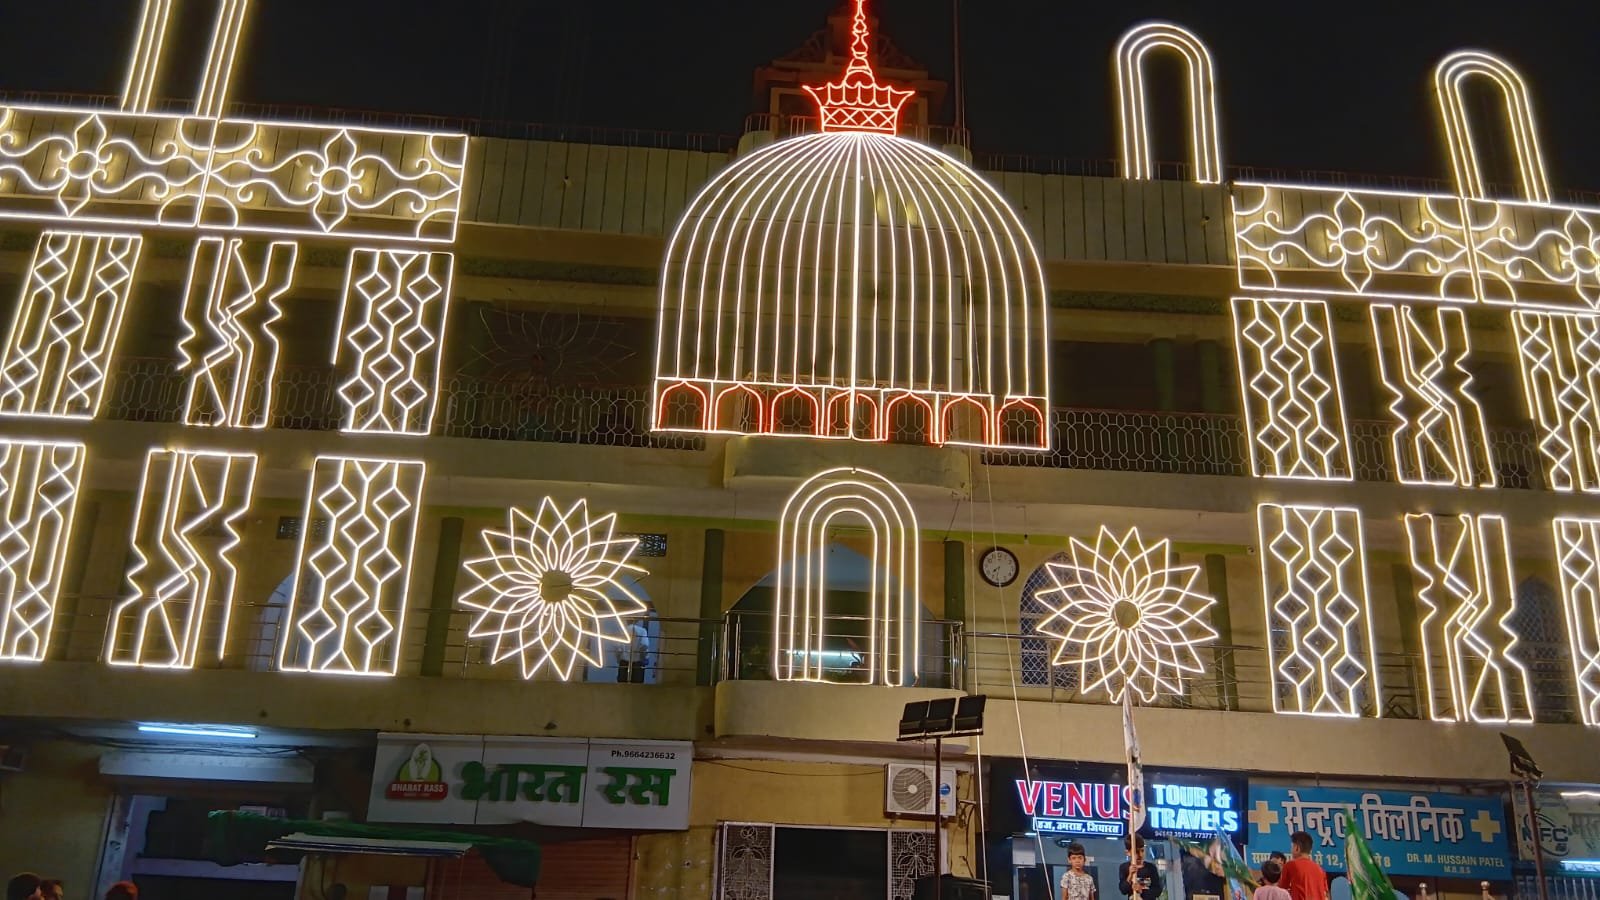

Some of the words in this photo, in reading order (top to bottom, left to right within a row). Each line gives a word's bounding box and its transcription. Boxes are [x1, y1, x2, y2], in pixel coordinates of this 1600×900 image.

[391, 783, 421, 793] BHARAT
[423, 784, 444, 793] RASS
[461, 761, 588, 803] भारत
[602, 766, 677, 806] रस
[1152, 783, 1208, 809] TOUR
[1213, 788, 1231, 809] &
[1148, 807, 1238, 832] TRAVELS
[1360, 793, 1465, 843] क्लिनिक
[1406, 852, 1422, 863] DR.
[1424, 853, 1435, 864] M.
[1437, 854, 1477, 866] HUSSAIN
[1478, 856, 1505, 868] PATEL
